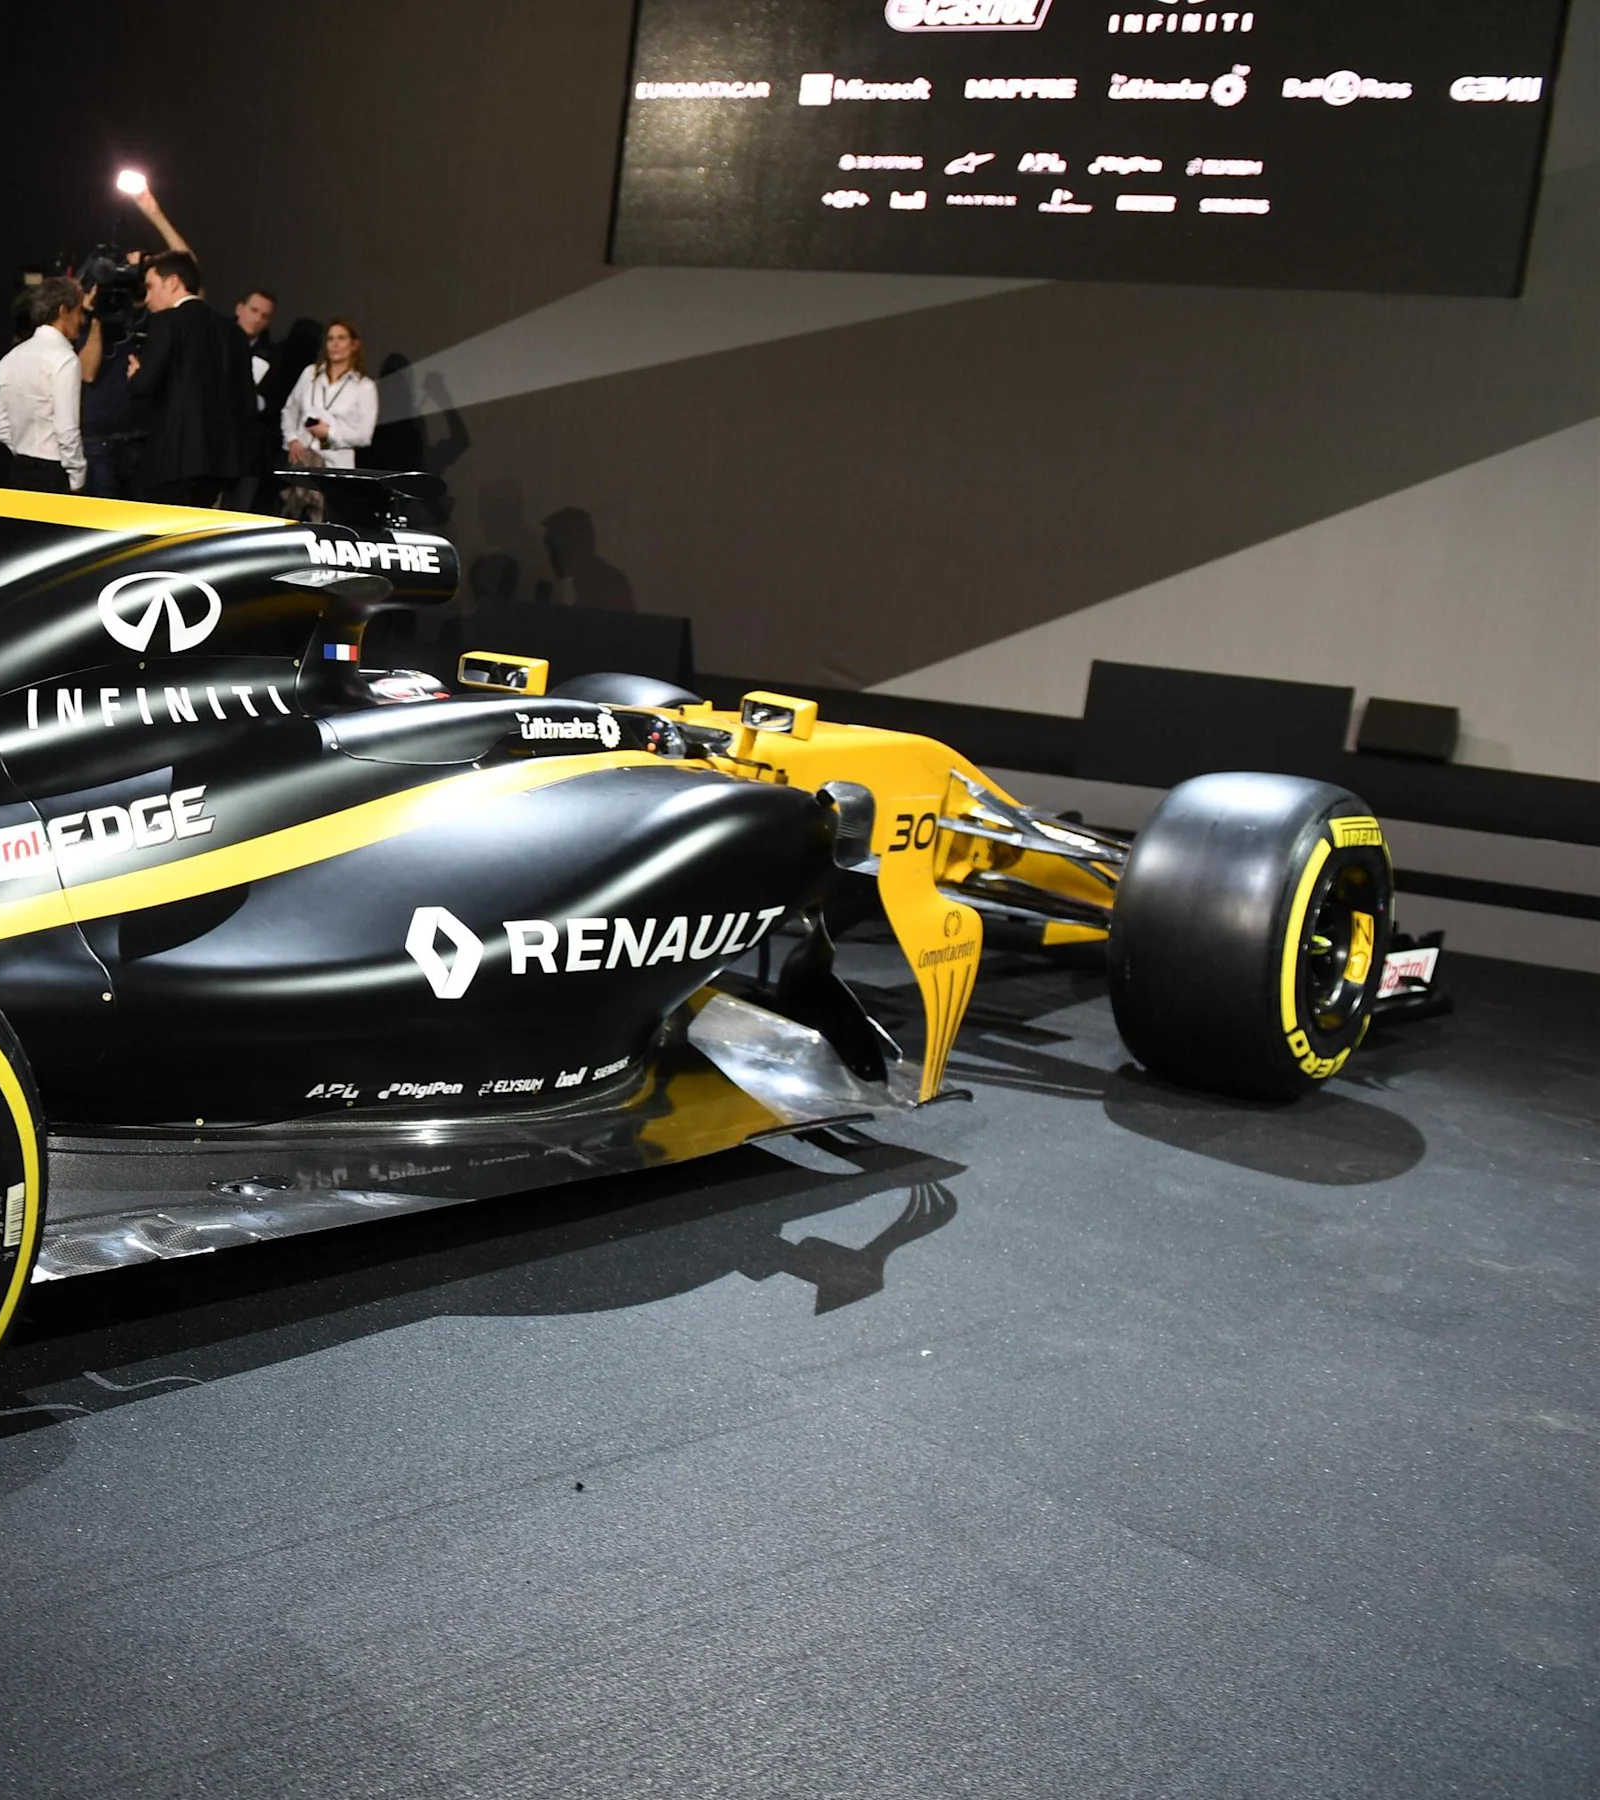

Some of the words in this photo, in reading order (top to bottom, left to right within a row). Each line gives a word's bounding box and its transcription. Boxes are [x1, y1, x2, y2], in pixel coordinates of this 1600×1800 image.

[1108, 12, 1254, 33] INFINITI
[832, 77, 932, 100] Microsoft
[964, 78, 1077, 98] MAPFRE
[307, 539, 441, 573] MAPFRE
[27, 685, 292, 730] INFINITI
[46, 785, 217, 852] EDGE
[888, 813, 937, 852] 30
[1328, 816, 1383, 848] PIRELLI
[503, 905, 786, 975] RENAULT
[918, 940, 976, 969] Computacenter
[592, 1056, 630, 1081] SIEMENS
[1287, 1029, 1351, 1079] ZERO
[399, 1081, 464, 1099] DigiPen
[493, 1078, 545, 1093] ELYSIUM
[554, 1066, 588, 1089] ixell
